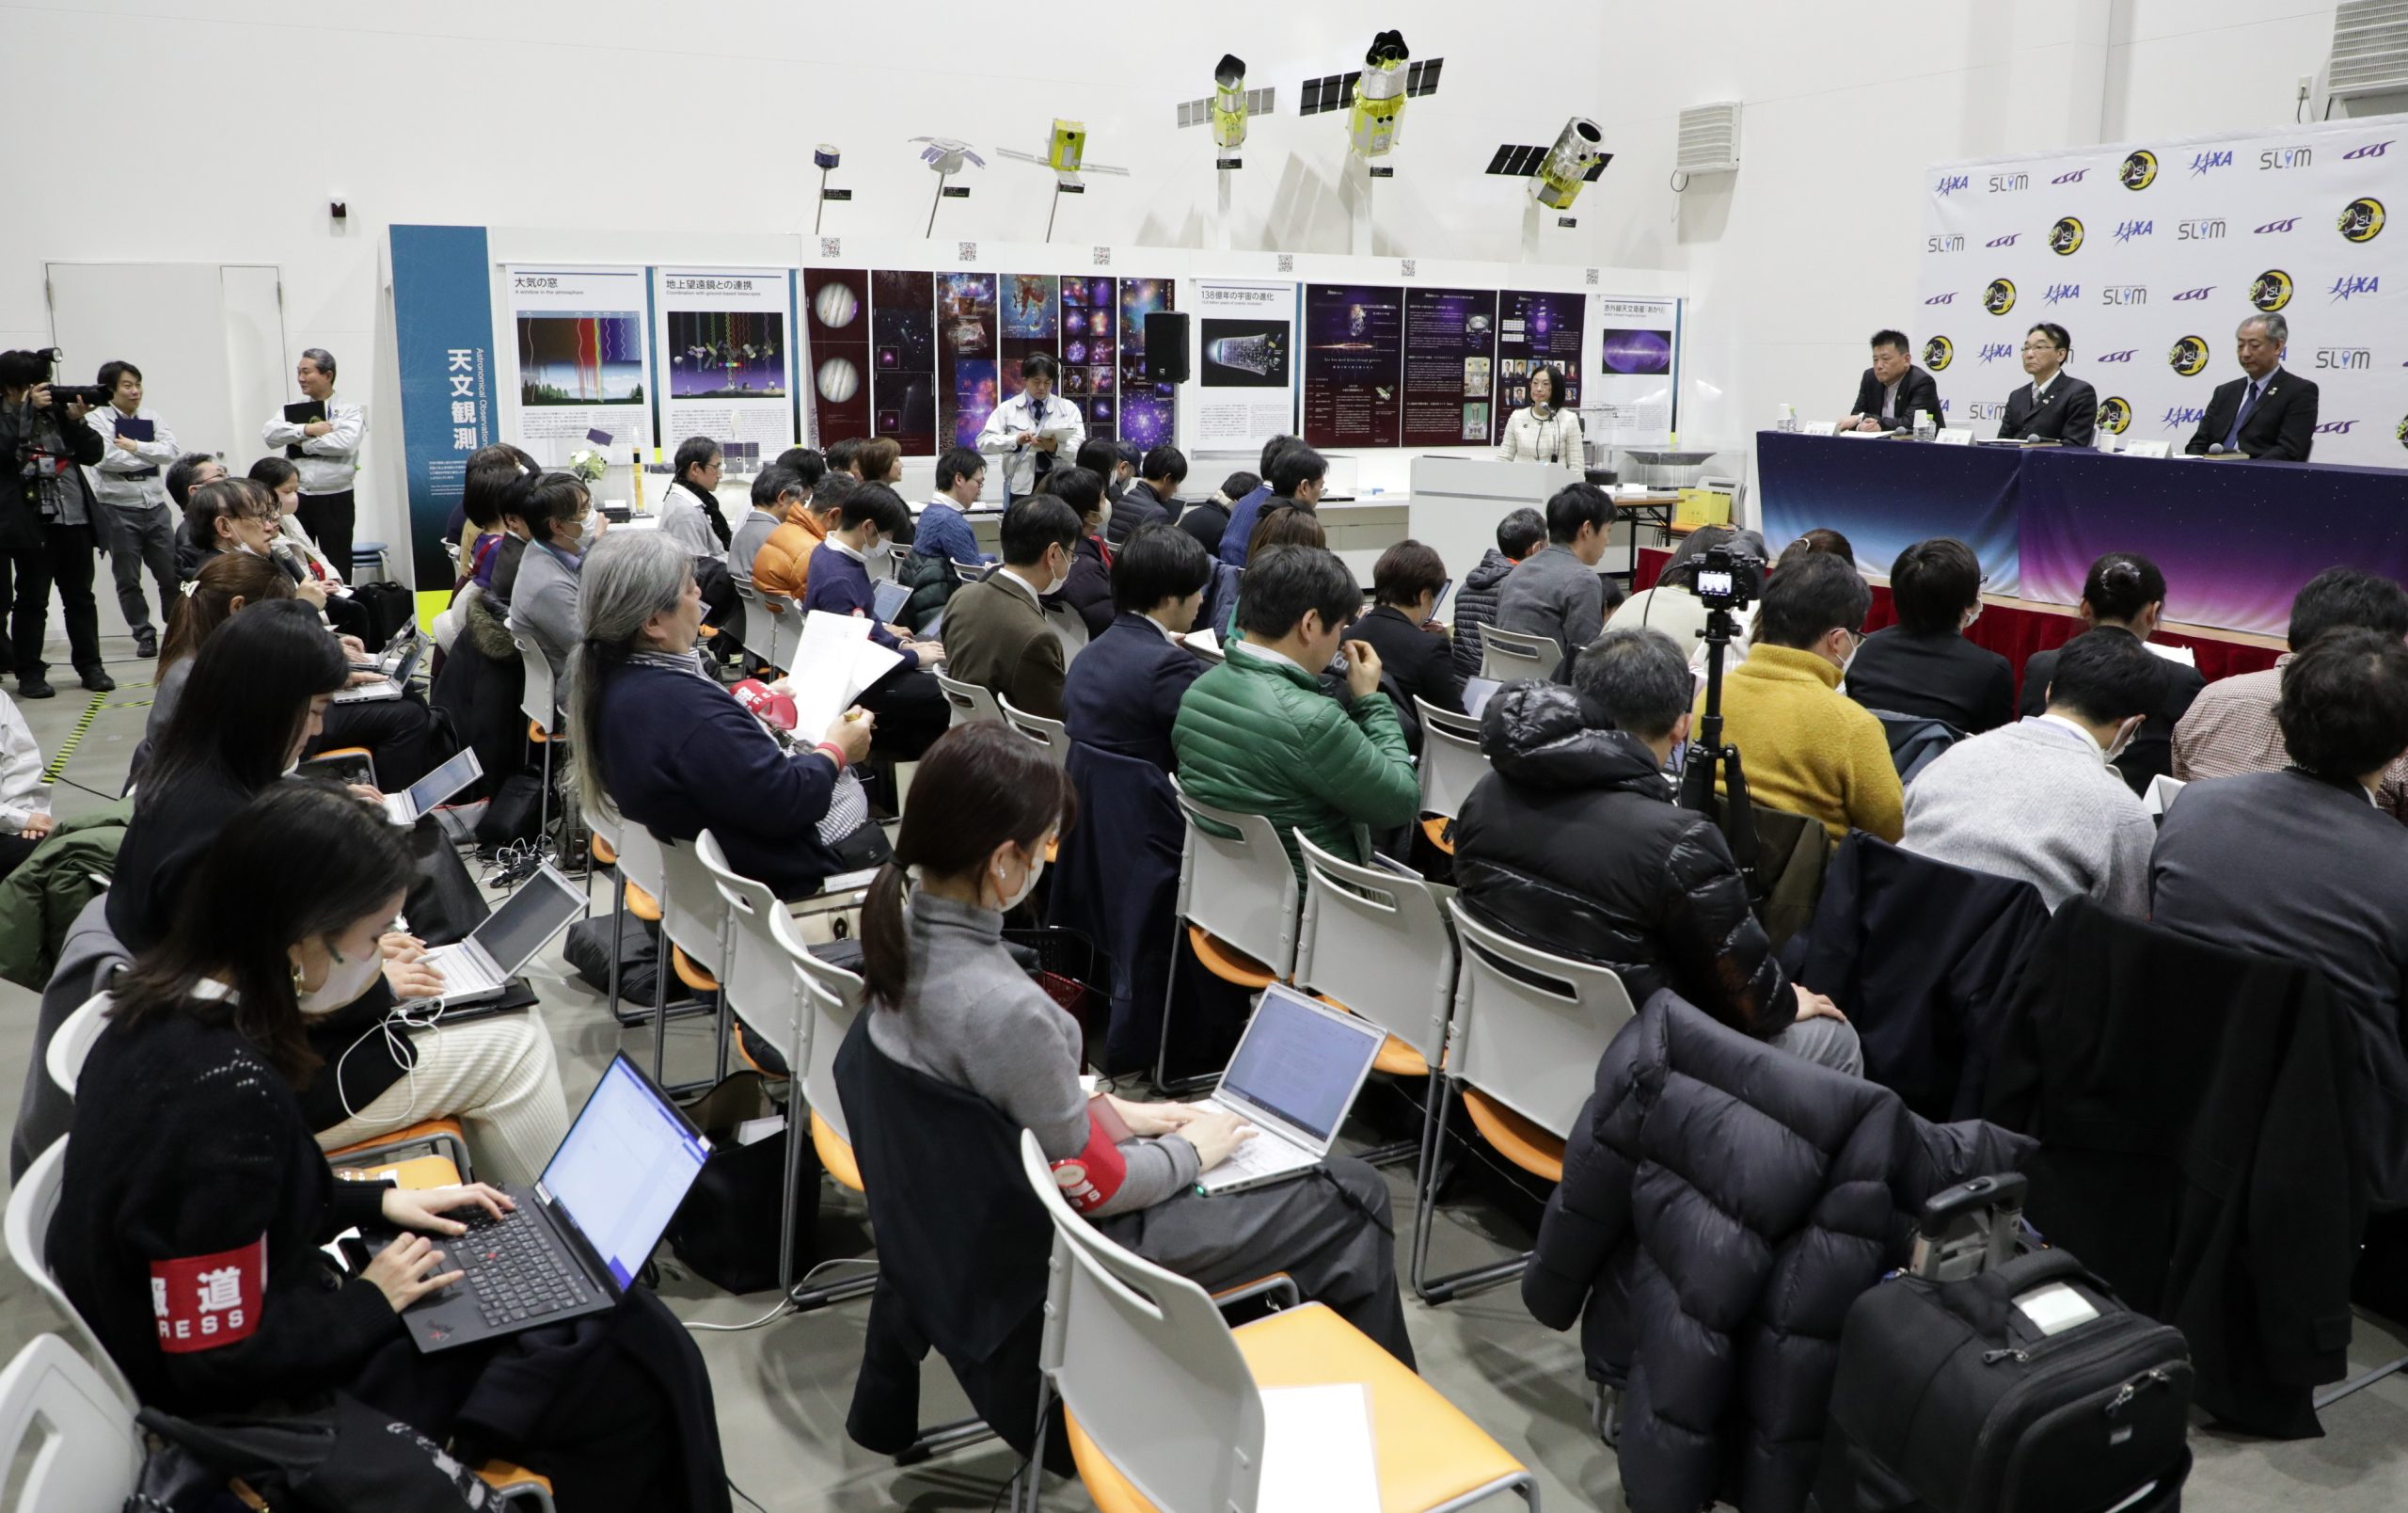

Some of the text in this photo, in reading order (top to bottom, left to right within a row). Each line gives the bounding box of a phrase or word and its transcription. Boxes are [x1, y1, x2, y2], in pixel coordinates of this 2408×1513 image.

[2189, 151, 2233, 179] JAXA
[2259, 148, 2312, 170] SLIM
[1935, 175, 1969, 199] JAXA
[1988, 174, 2029, 193] SLIM
[2114, 219, 2153, 246] JAXA
[2178, 220, 2226, 240] SLIM
[1928, 235, 1965, 253] SLIM
[515, 278, 558, 288] 大気の窓
[666, 279, 753, 291] 地上望遠鏡との連携
[2327, 274, 2379, 304] JAXA
[1201, 291, 1275, 302] 138億年の宇宙の進化
[2042, 283, 2080, 307] JAXA
[2102, 287, 2147, 306] SLIM
[1978, 342, 2012, 365] JAXA
[2316, 349, 2370, 370] SLIM
[476, 347, 486, 398] Astronomical
[448, 349, 478, 450] 天文観測
[158, 1309, 244, 1339] RESS
